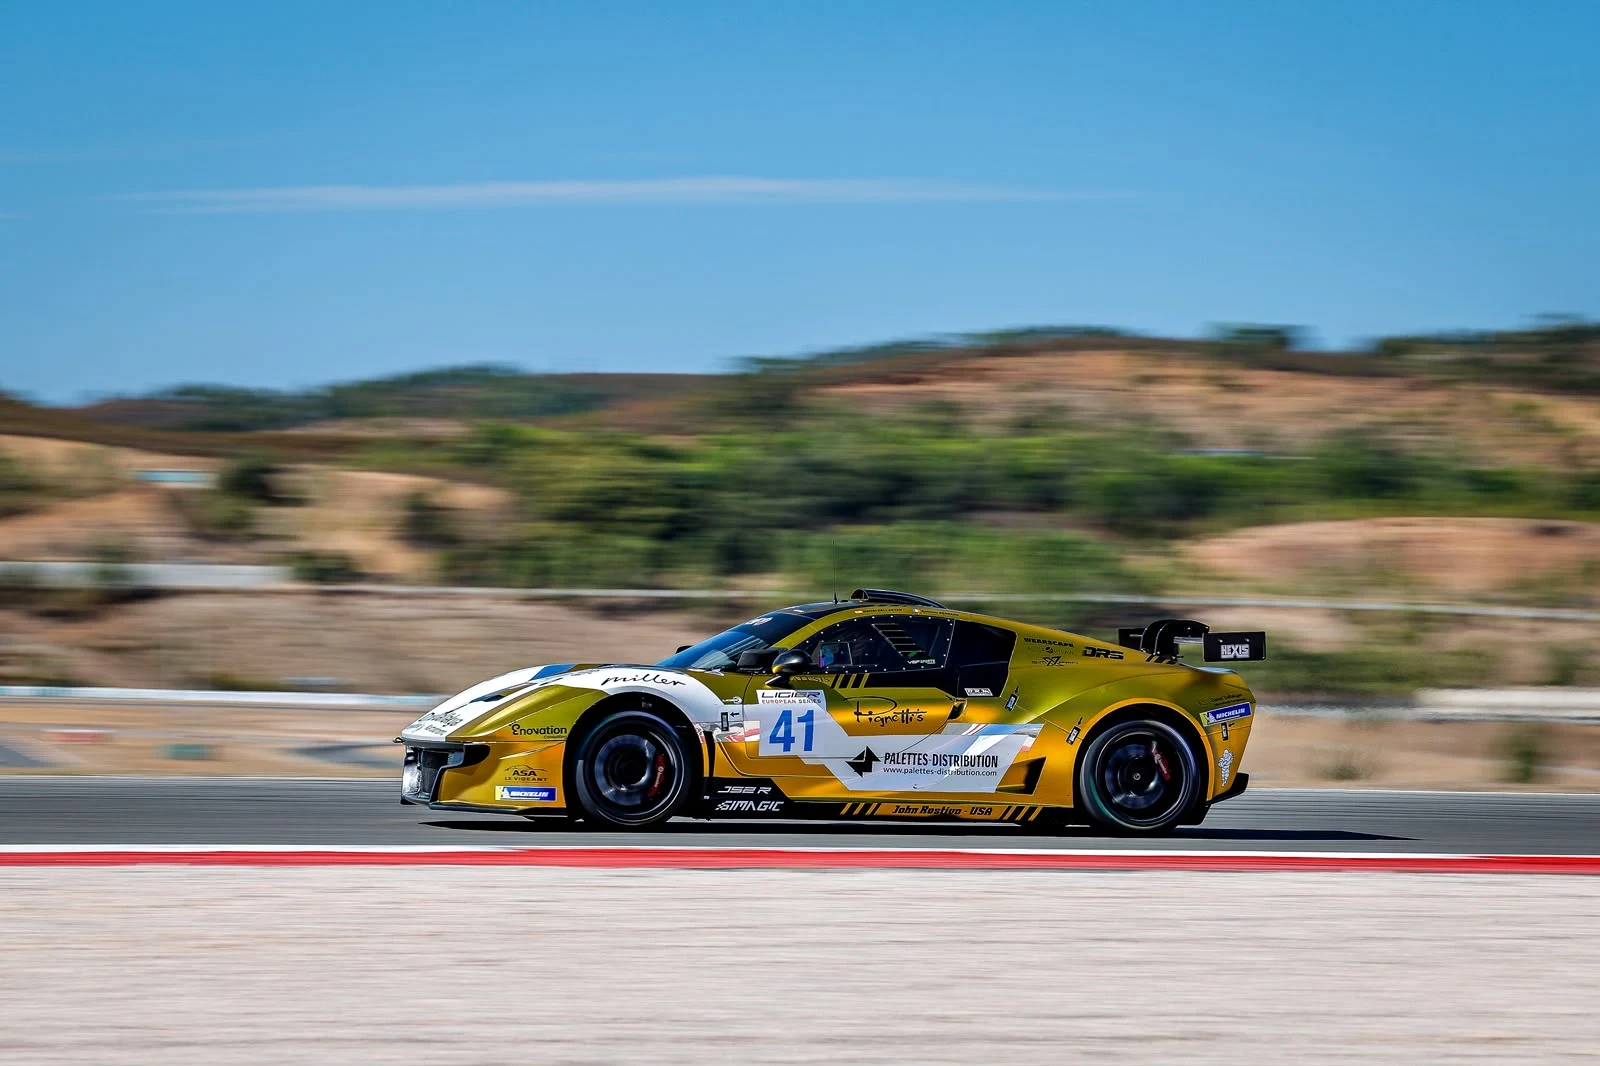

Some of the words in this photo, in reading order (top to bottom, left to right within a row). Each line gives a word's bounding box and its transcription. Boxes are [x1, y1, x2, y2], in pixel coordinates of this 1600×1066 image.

[1024, 638, 1074, 648] WEARSCAPE
[1082, 646, 1124, 660] DRS
[1221, 645, 1249, 658] HEXIS
[601, 673, 686, 686] miller
[1215, 708, 1246, 720] MICHELIN
[769, 709, 815, 752] 41
[884, 753, 998, 768] PALETTES-DISTRIBUTION
[512, 769, 537, 777] ASA
[883, 766, 997, 776] www.palettes-distribution.com
[757, 786, 772, 794] R
[715, 800, 785, 812] SIMAGIC
[892, 805, 919, 813] John
[970, 806, 993, 815] USA
